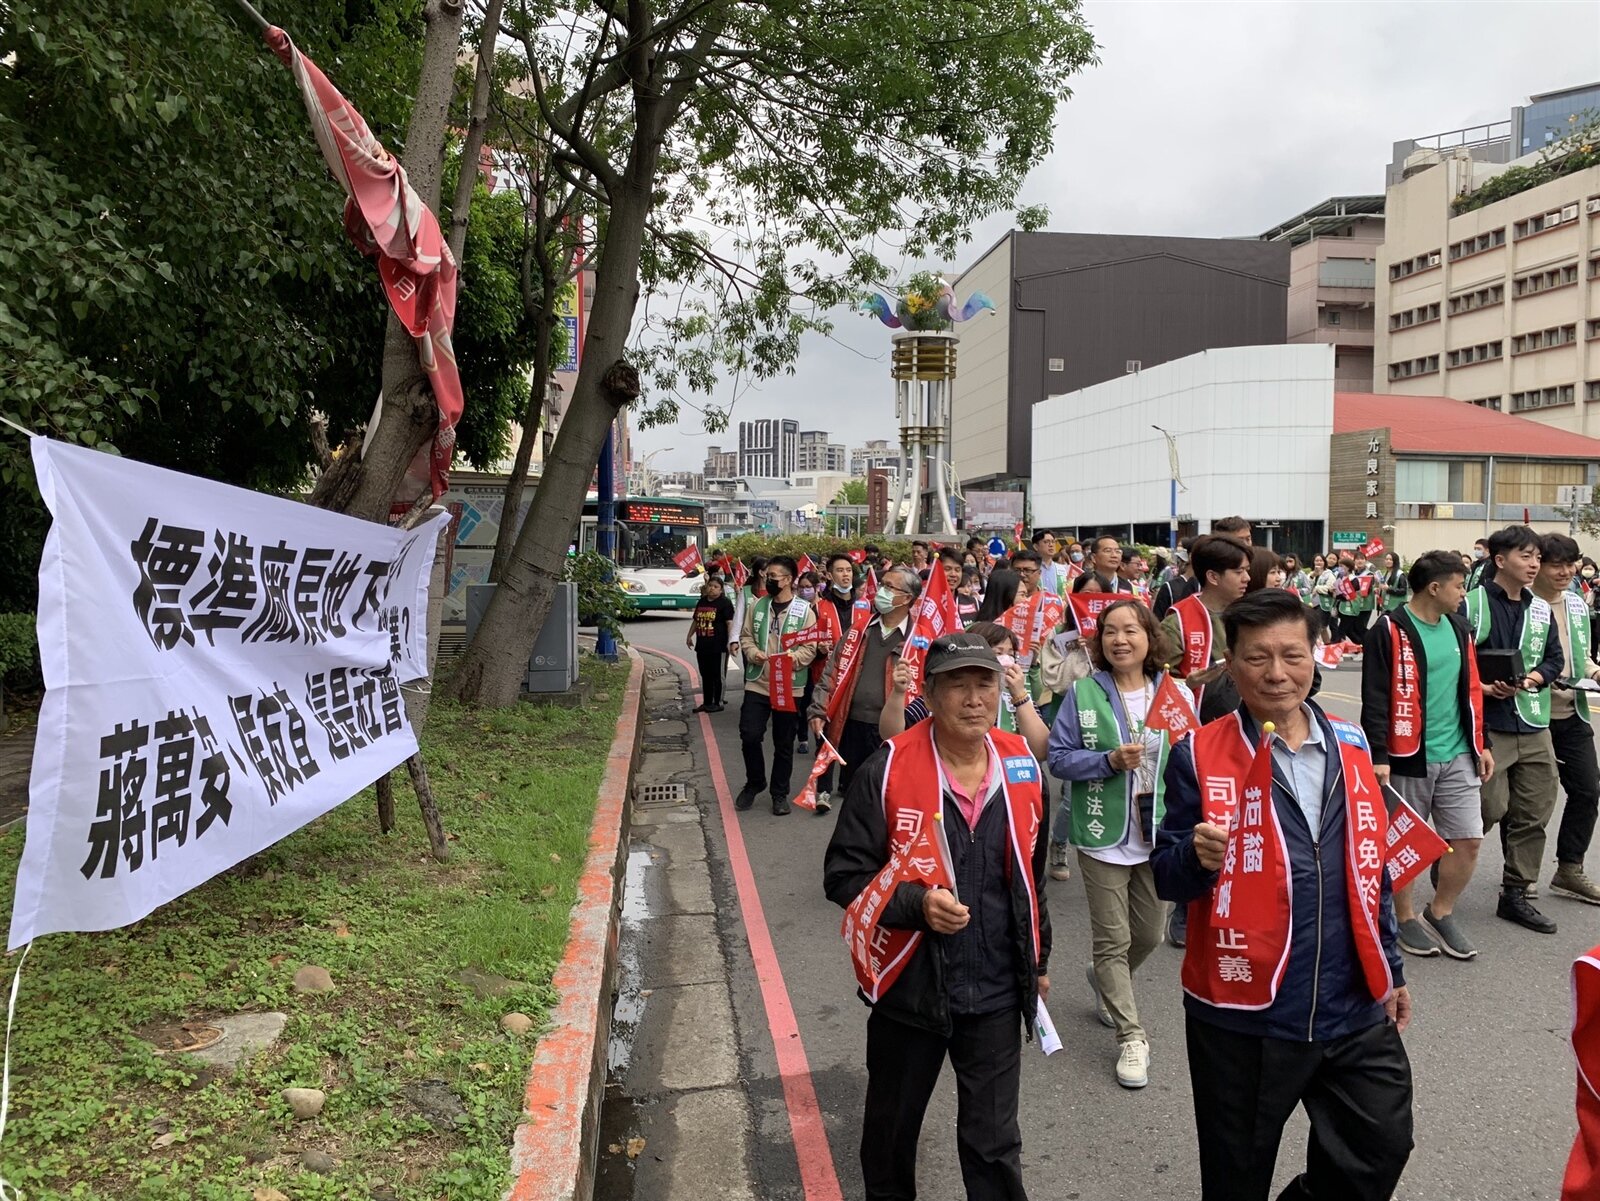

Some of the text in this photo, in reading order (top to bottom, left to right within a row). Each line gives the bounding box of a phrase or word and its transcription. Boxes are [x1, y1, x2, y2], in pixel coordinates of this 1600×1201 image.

[1077, 710, 1107, 840] 遵守保法令
[1205, 775, 1253, 983] 司法正義
[1242, 786, 1265, 874] 拒絕
[1351, 764, 1382, 922] 人民免於
[1385, 811, 1416, 850] 頑固
[1385, 844, 1422, 882] 拒絕
